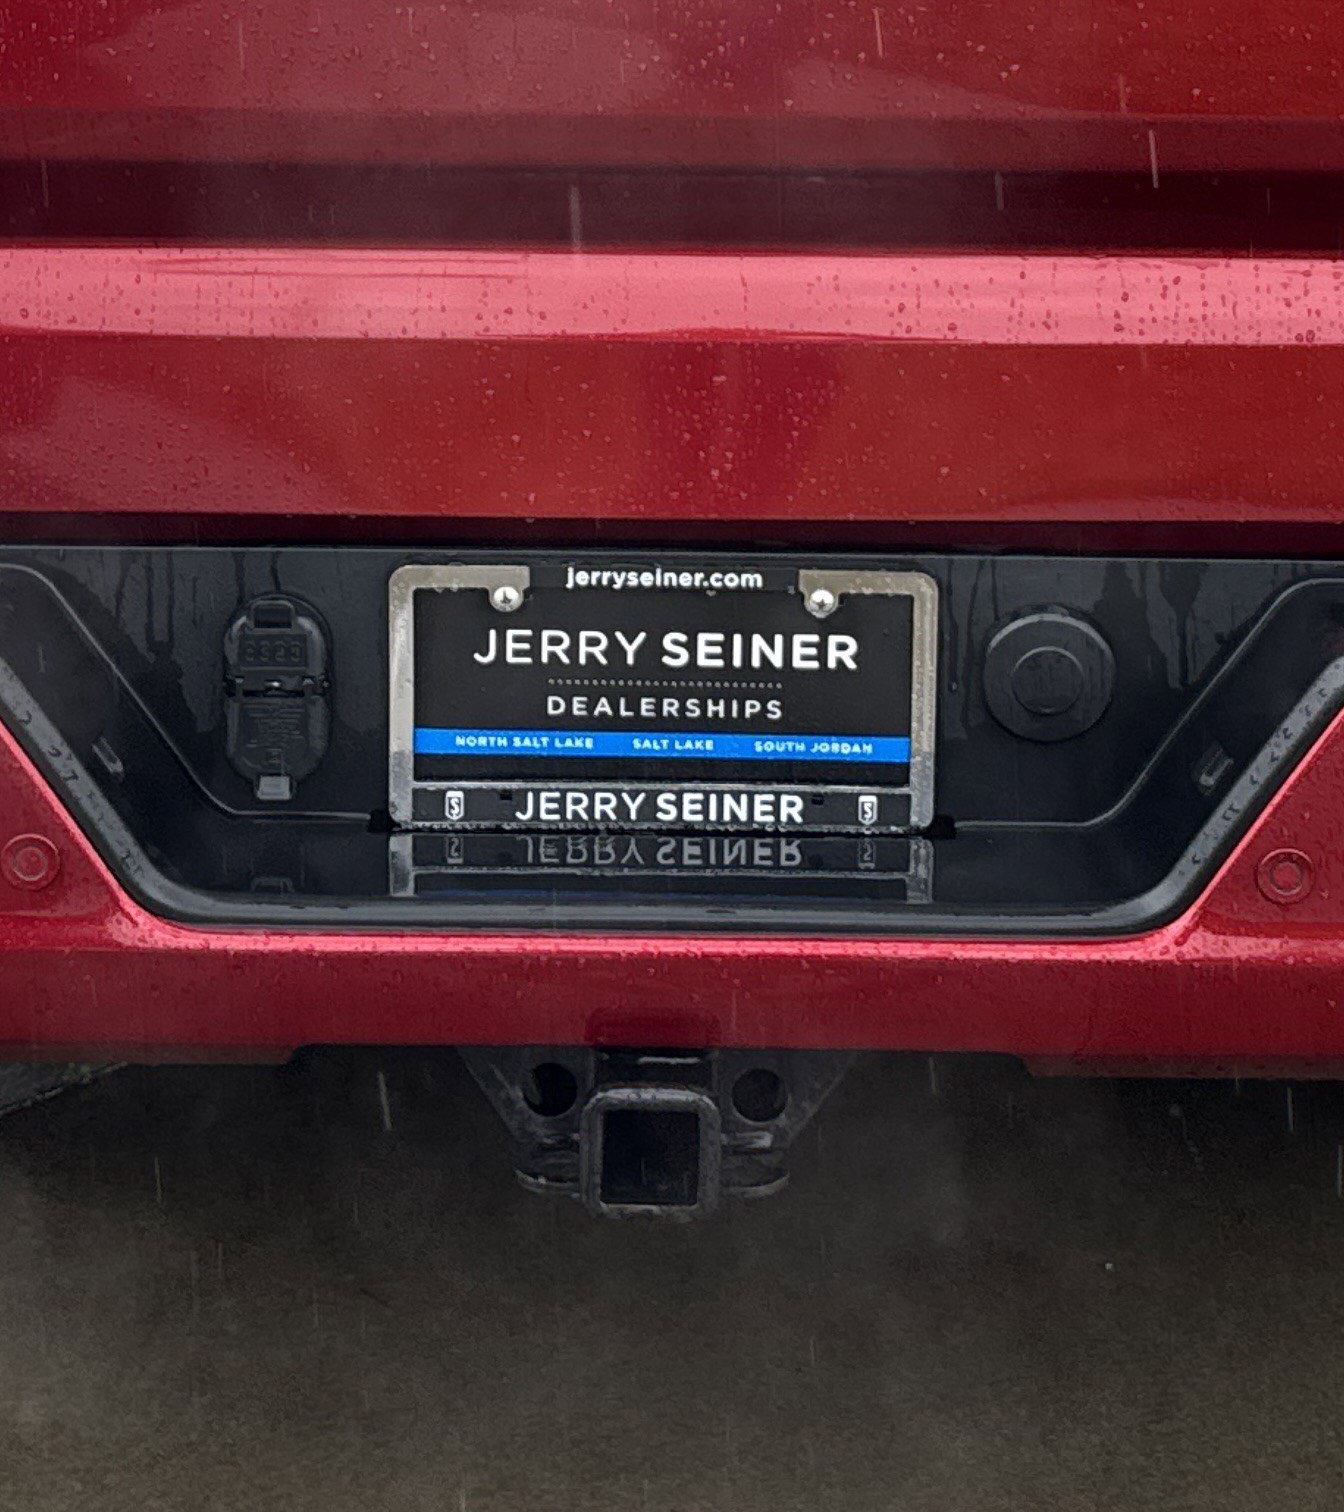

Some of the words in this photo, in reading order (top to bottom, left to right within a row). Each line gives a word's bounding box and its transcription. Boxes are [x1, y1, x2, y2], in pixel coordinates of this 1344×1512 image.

[565, 567, 763, 590] jerryseiner.com
[473, 629, 647, 667] JERRY
[660, 631, 859, 671] SEINER
[546, 696, 784, 721] DEALERSHIPS
[455, 735, 508, 749] NORTH
[513, 736, 550, 749] SALT
[554, 737, 595, 750] LAKE
[632, 738, 672, 751] SALT
[675, 739, 715, 752] LAKE
[754, 740, 806, 754] SOUTH
[810, 741, 874, 755] JORDAN
[515, 791, 646, 821] JERRY
[656, 793, 804, 824] SEINER
